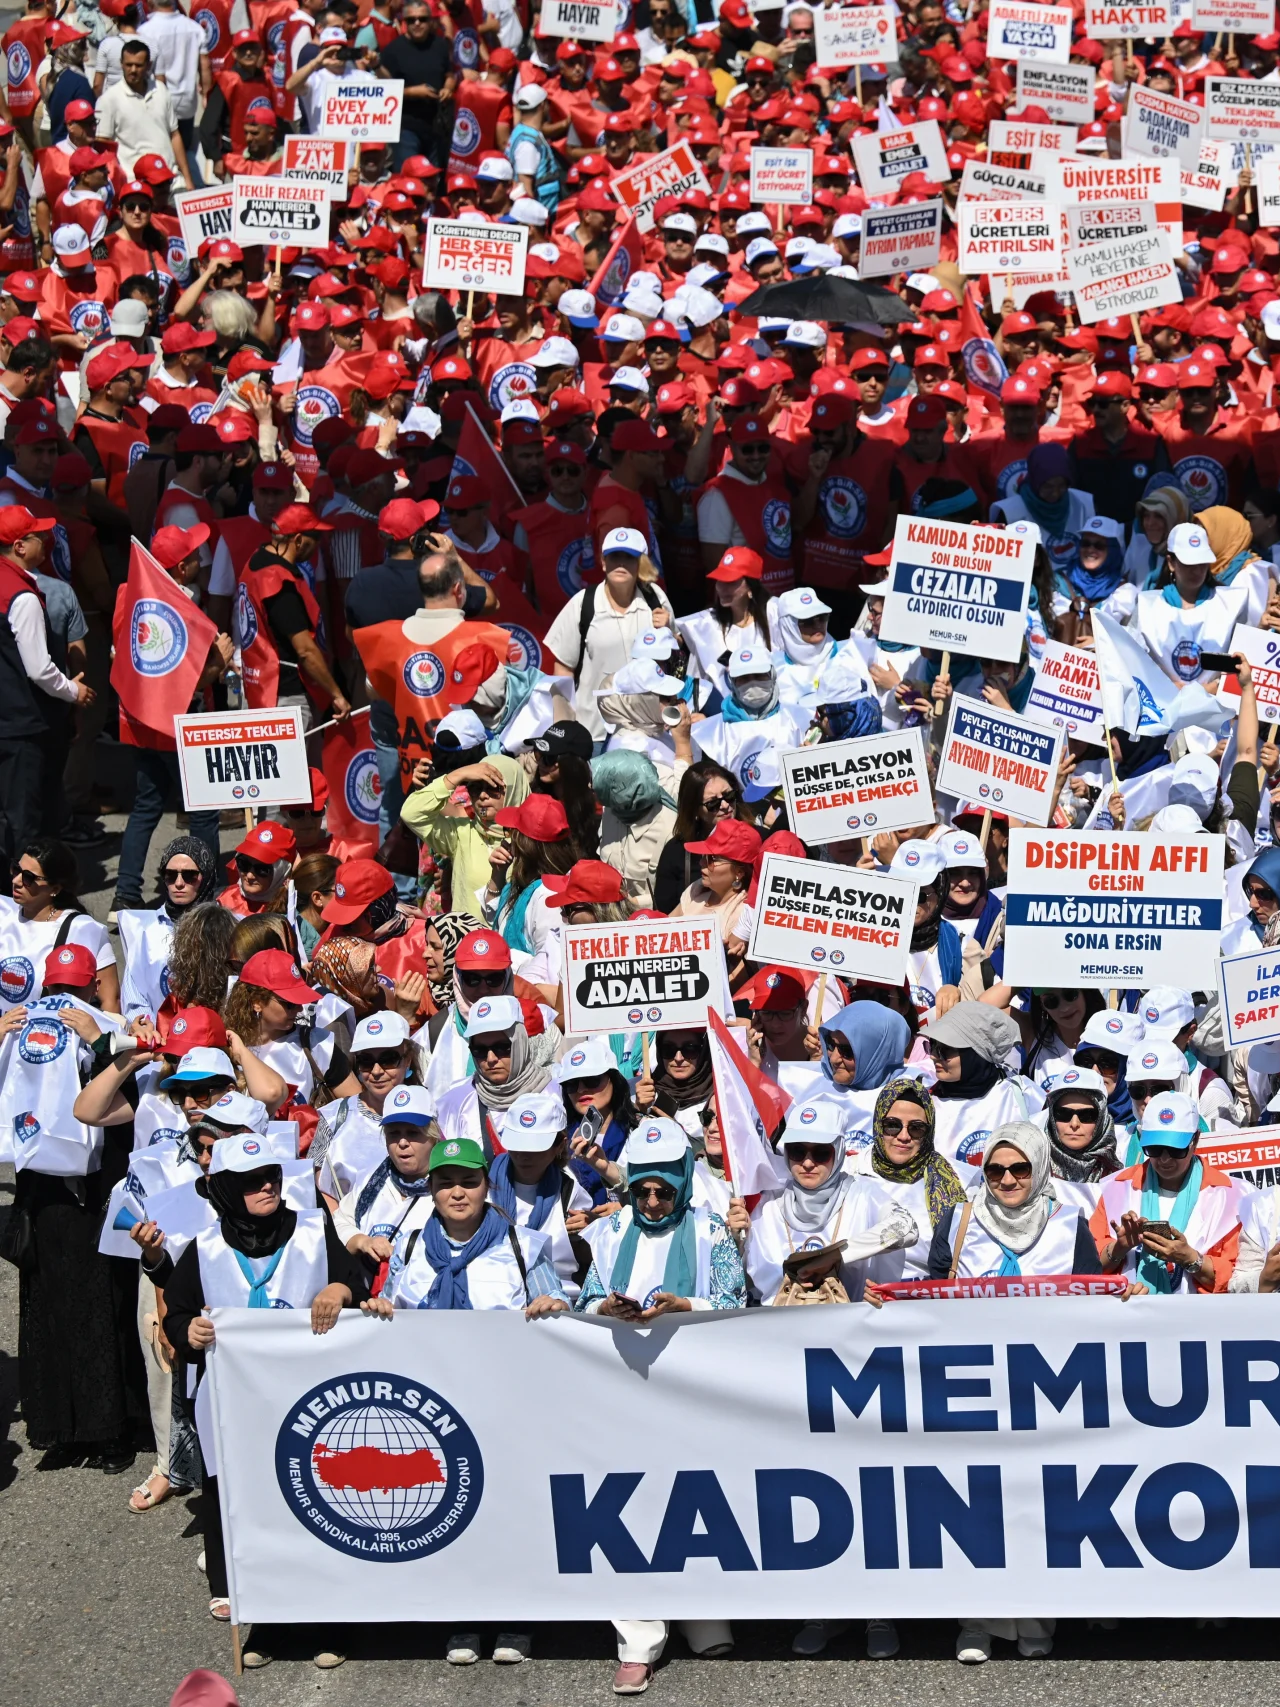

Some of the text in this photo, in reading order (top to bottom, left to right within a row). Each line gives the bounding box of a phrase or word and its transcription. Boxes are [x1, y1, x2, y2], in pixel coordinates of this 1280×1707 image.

[558, 4, 600, 26] HAYIR
[1091, 8, 1166, 25] HAKTIR
[338, 86, 384, 98] MEMUR
[327, 97, 366, 113] ÜVEY
[326, 112, 371, 125] EVLAT
[295, 150, 335, 170] ZAM
[281, 185, 325, 201] REZALET
[275, 202, 311, 213] NEREDE
[975, 207, 1044, 222] EK DERS
[245, 209, 316, 229] ADALET
[435, 224, 520, 242] ÖĞRETMENE DEĞER
[440, 237, 513, 256] HER ŞEYE
[967, 239, 1055, 254] ARTIRILSIN
[438, 250, 512, 276] DEĞER
[907, 523, 968, 549] KAMUDA
[931, 551, 992, 573] SON BULSUN
[912, 568, 998, 607] CEZALAR
[907, 598, 1005, 627] CAYDIRICI OLSUN
[929, 629, 968, 644] MEMUR-SEN
[1031, 692, 1065, 710] MEMUR
[961, 712, 1049, 750] DEVLET ÇALIŞANLARI
[963, 725, 1041, 761] ARASINDA
[205, 744, 281, 784] HAYIR
[793, 747, 914, 781] ENFLASYON
[948, 740, 1049, 793] AYRIM YAPMAZ
[794, 767, 916, 797] DÜŞSE DE, ÇIKSA DA
[1150, 845, 1208, 872] AFFI
[771, 876, 904, 913] ENFLASYON
[767, 897, 901, 929] DÜŞSE DE, ÇIKSA DA
[635, 929, 712, 956] REZALET
[1064, 933, 1109, 950] SONA
[632, 957, 691, 974] NEREDE
[1080, 964, 1144, 976] MEMUR-SEN
[587, 973, 701, 1006] ADALET
[1234, 1007, 1278, 1029] ŞART
[290, 1380, 458, 1440] MEMUR-SEN
[288, 1456, 313, 1517] MEMUR
[396, 1456, 469, 1554] KONFEDERASYONU
[550, 1465, 1005, 1574] KADIN
[373, 1531, 401, 1543] 1995
